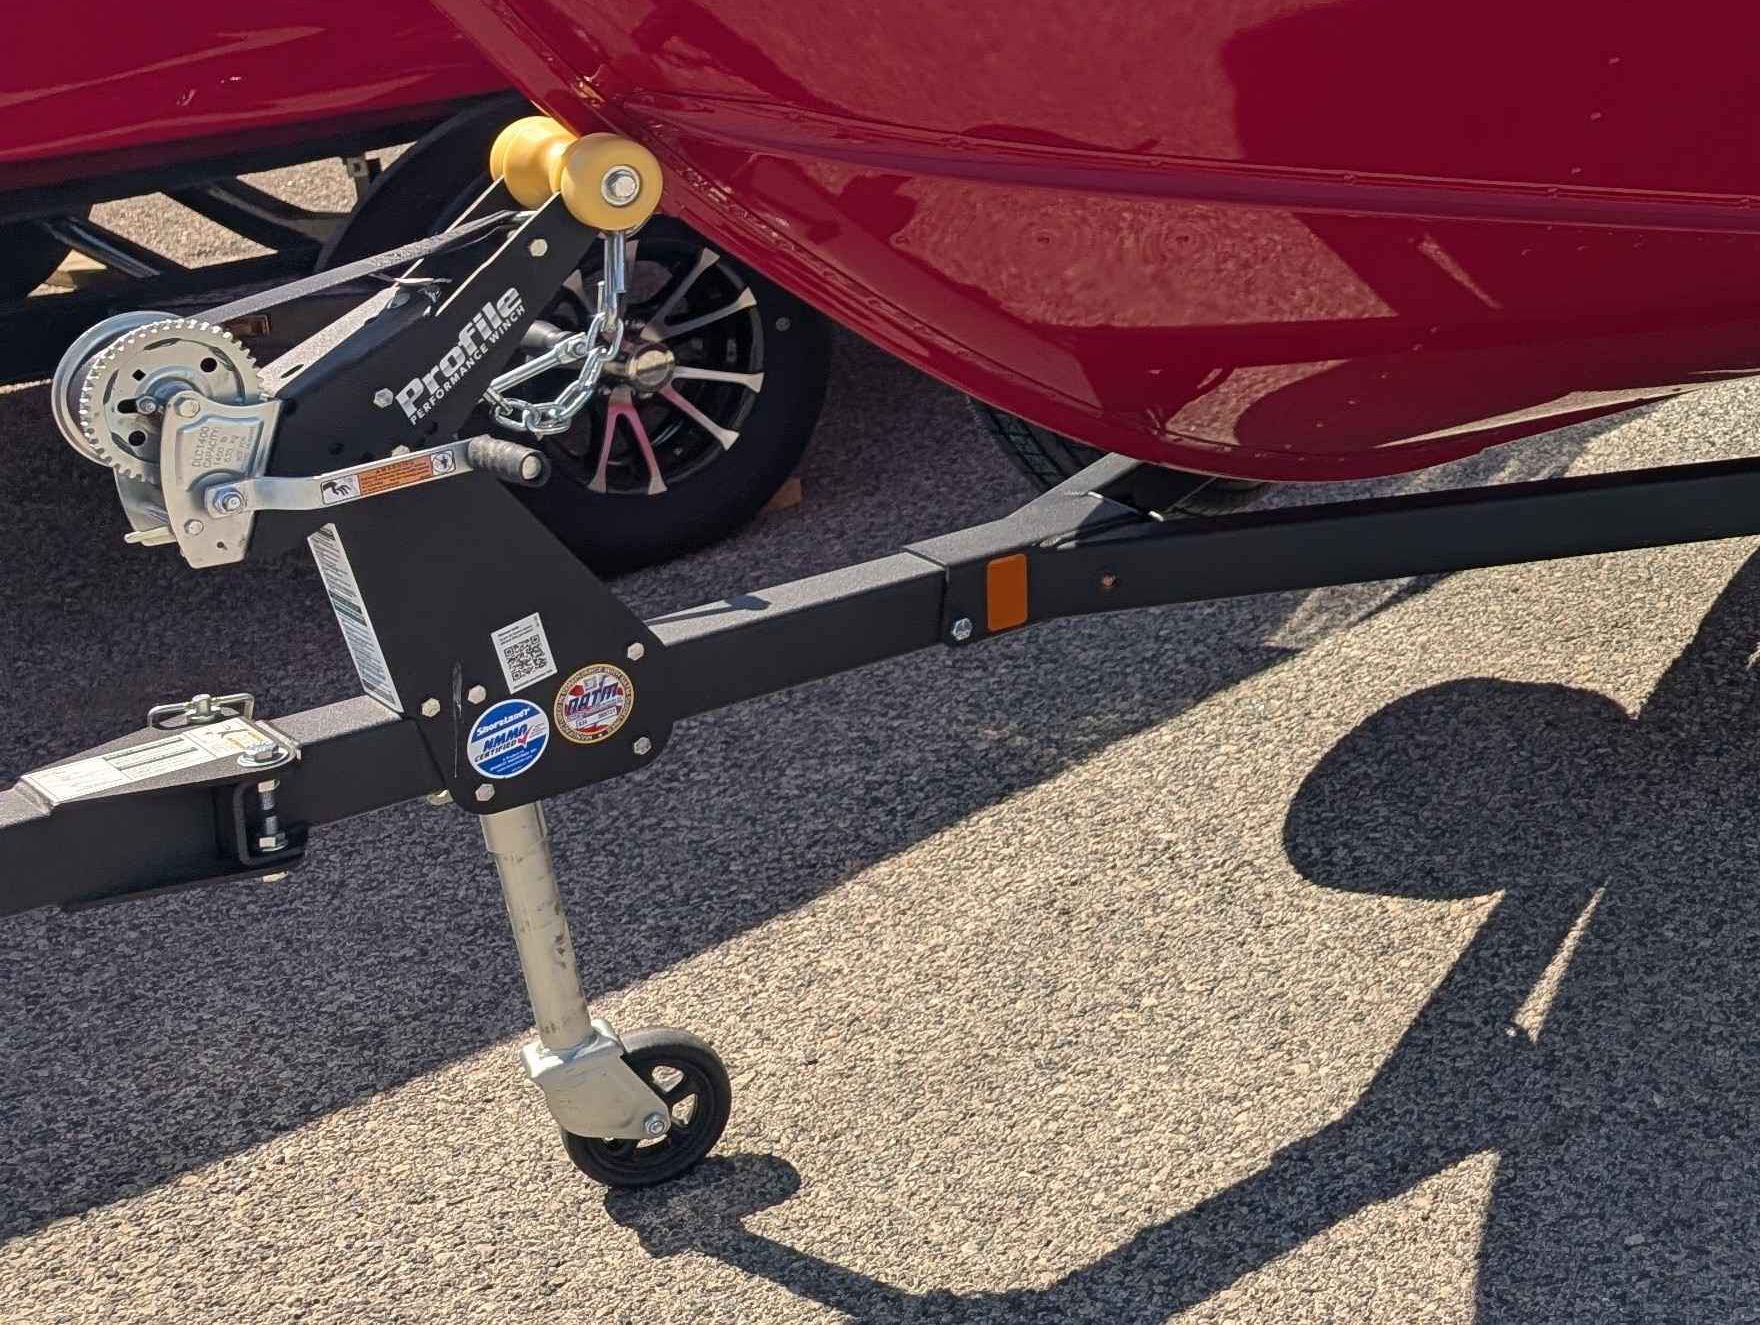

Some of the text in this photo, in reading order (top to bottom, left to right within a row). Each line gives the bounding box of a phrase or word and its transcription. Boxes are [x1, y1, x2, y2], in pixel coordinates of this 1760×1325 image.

[395, 287, 523, 418] Profile
[409, 305, 526, 426] PERFORMANCE WINCH
